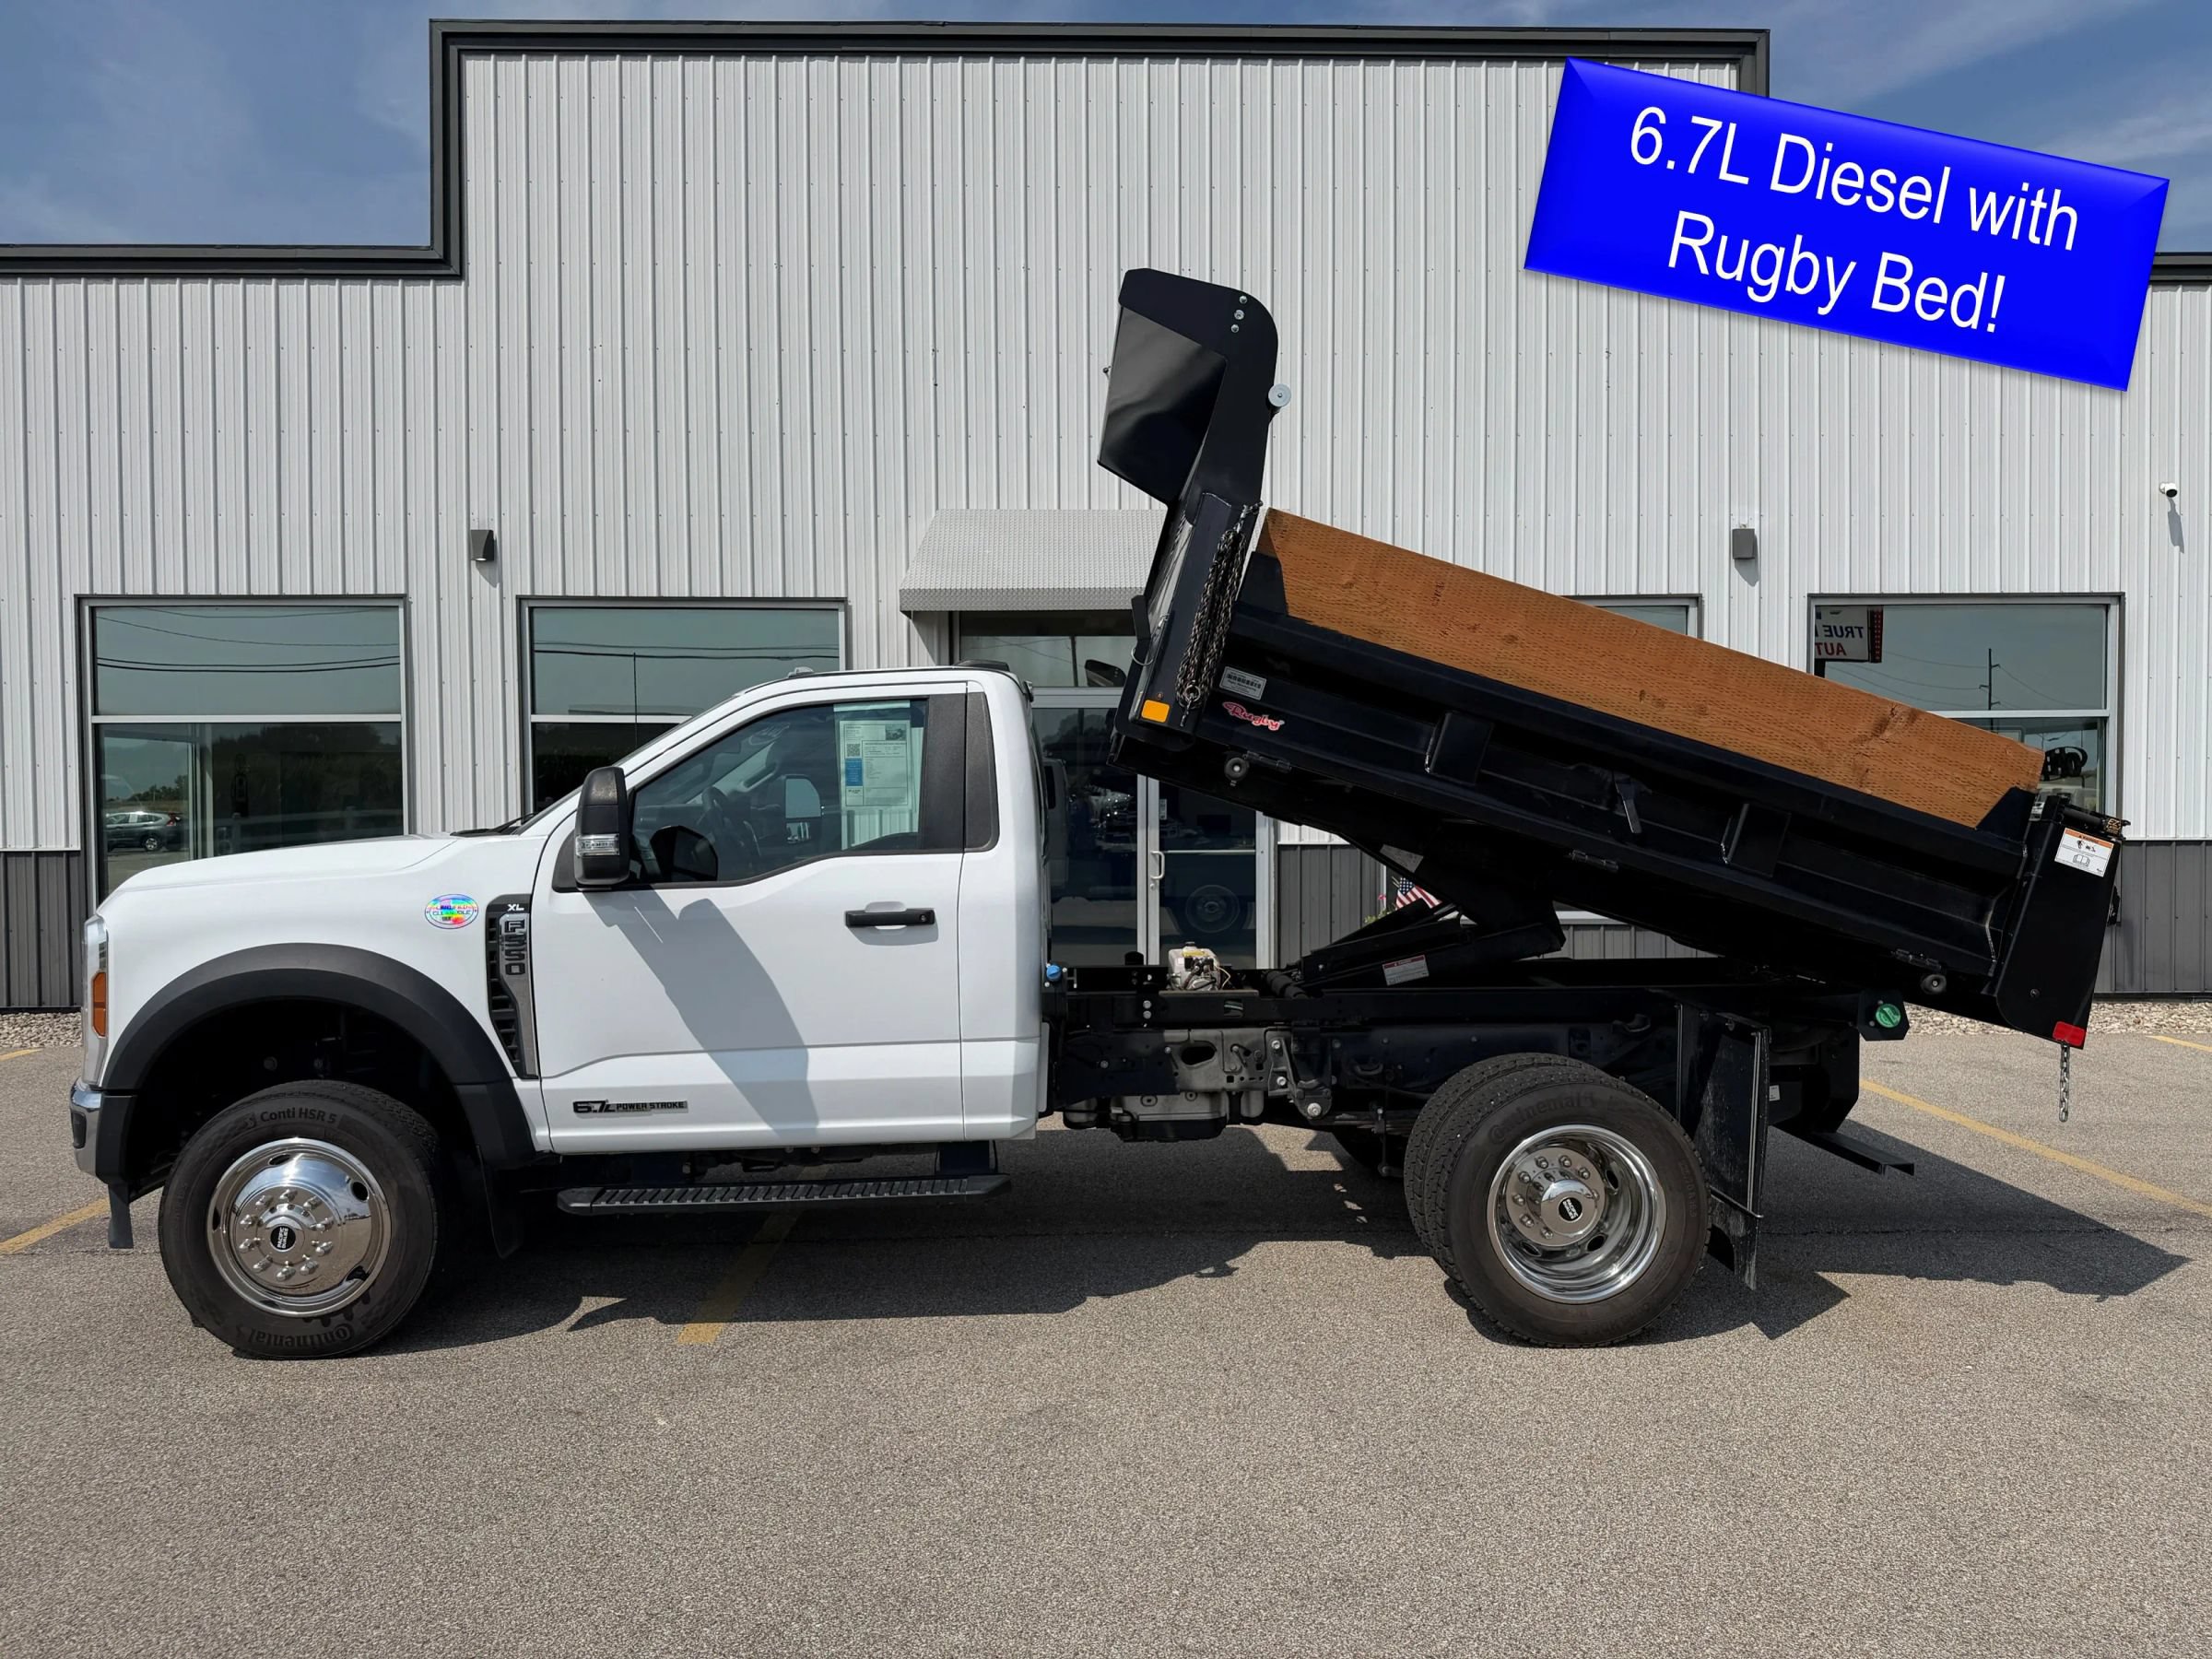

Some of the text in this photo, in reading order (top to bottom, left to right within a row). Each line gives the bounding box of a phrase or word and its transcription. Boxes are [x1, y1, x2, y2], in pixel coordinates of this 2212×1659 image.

[1222, 701, 1279, 731] Rugby
[617, 1102, 647, 1111] POWER
[649, 1101, 684, 1110] STROKE
[260, 1107, 295, 1122] Conti
[298, 1108, 326, 1122] HSR
